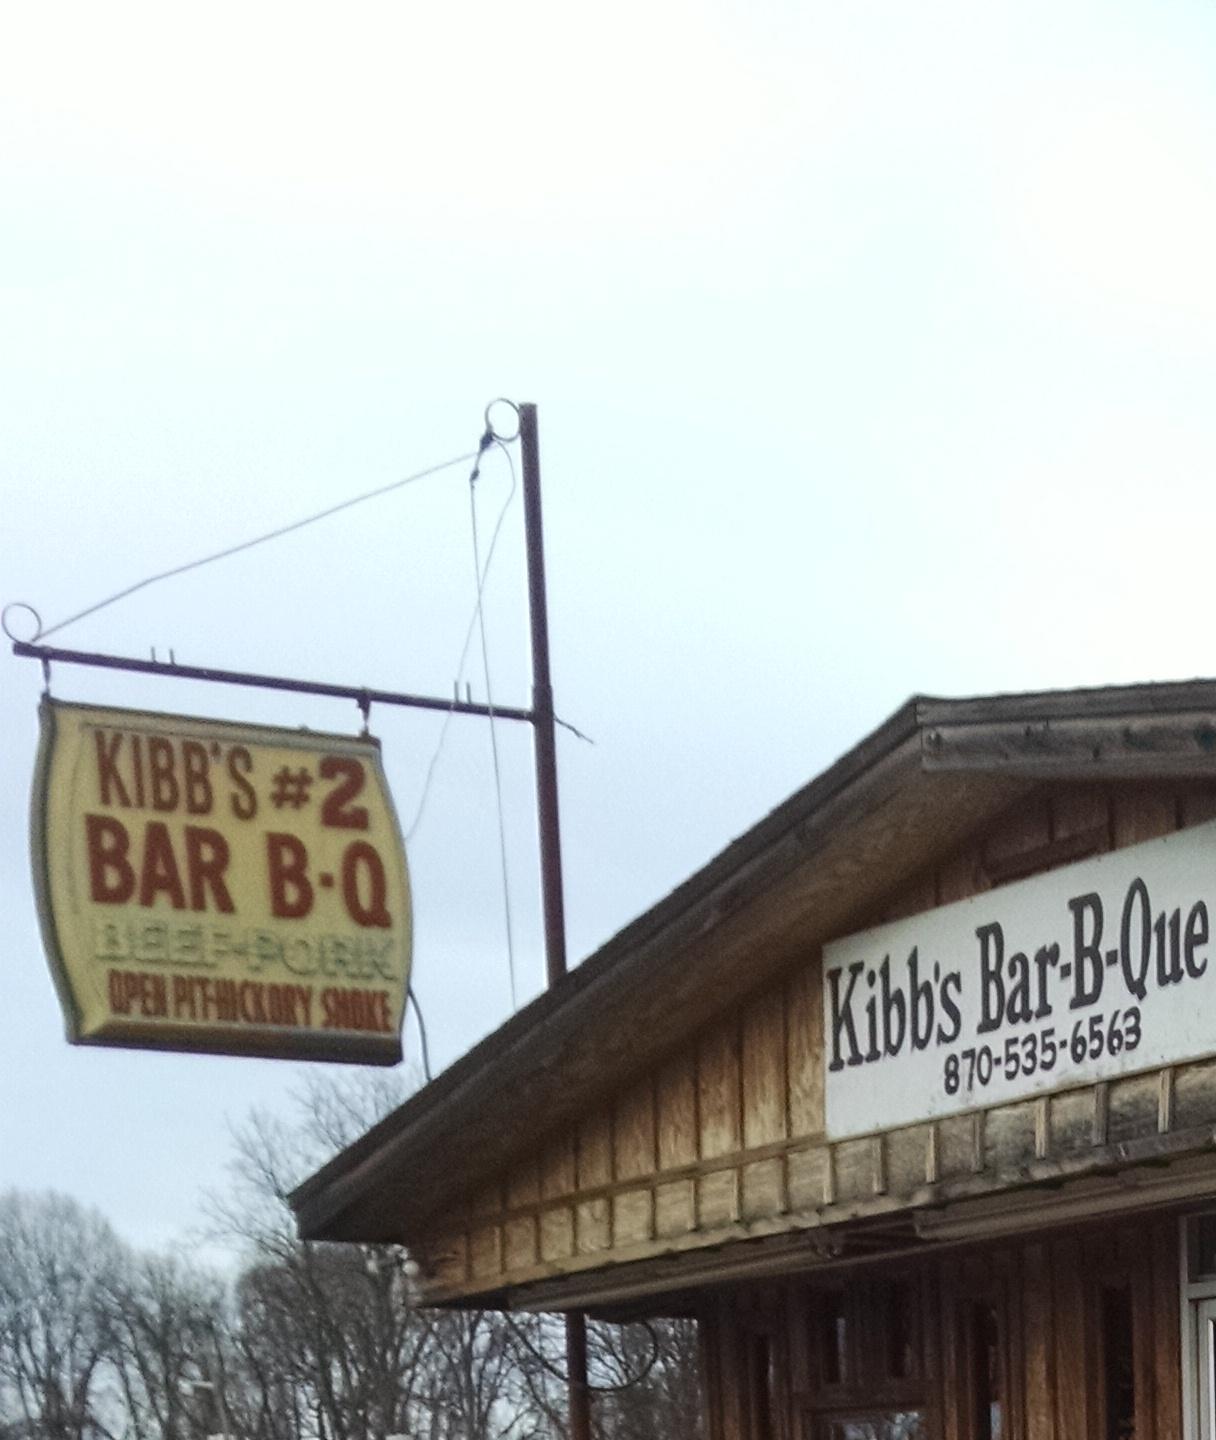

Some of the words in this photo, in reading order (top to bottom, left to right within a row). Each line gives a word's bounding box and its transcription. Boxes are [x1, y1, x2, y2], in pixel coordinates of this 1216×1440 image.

[94, 729, 258, 821] KIBB'S
[270, 755, 369, 831] #2
[85, 813, 236, 914] BAR
[826, 945, 962, 1072] Kibb's
[975, 876, 1210, 1036] Bar-B-Que
[943, 1005, 1142, 1096] 870-535-6563
